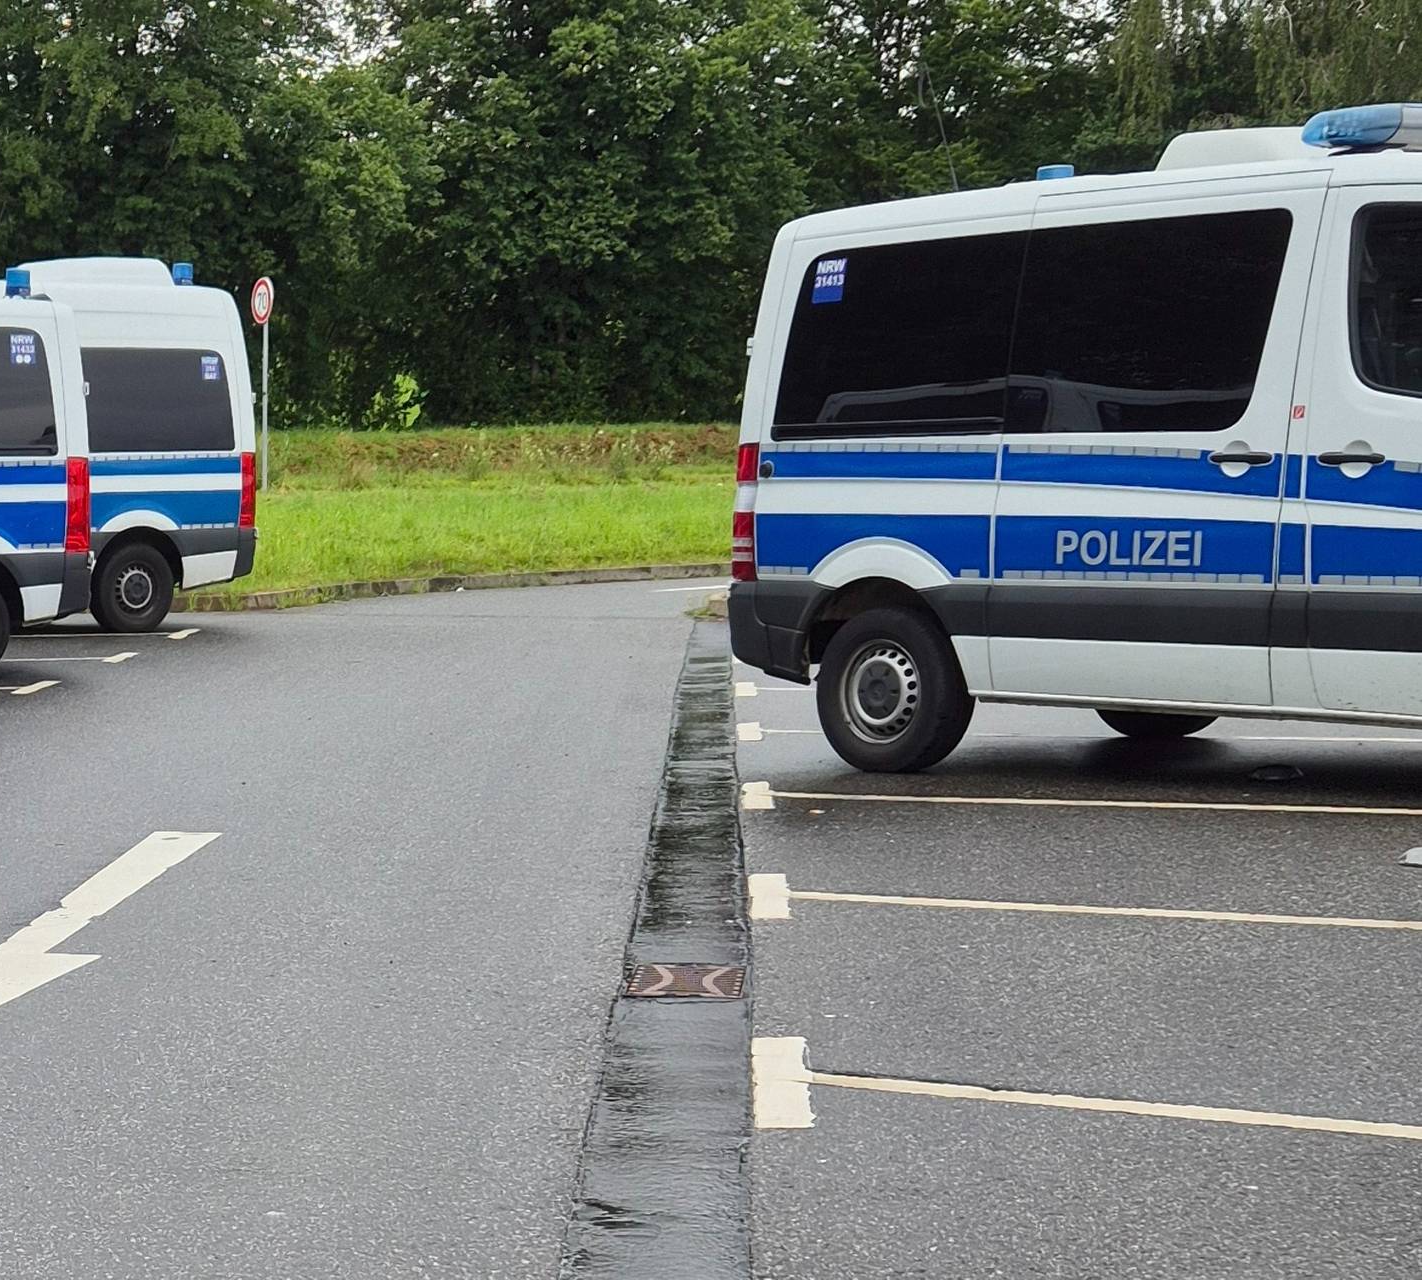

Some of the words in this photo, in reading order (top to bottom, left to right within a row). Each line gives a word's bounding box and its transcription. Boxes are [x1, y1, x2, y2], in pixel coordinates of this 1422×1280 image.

[816, 258, 847, 275] NRW
[257, 292, 268, 312] 70
[10, 335, 35, 345] NRW
[1055, 530, 1203, 567] POLIZEI
